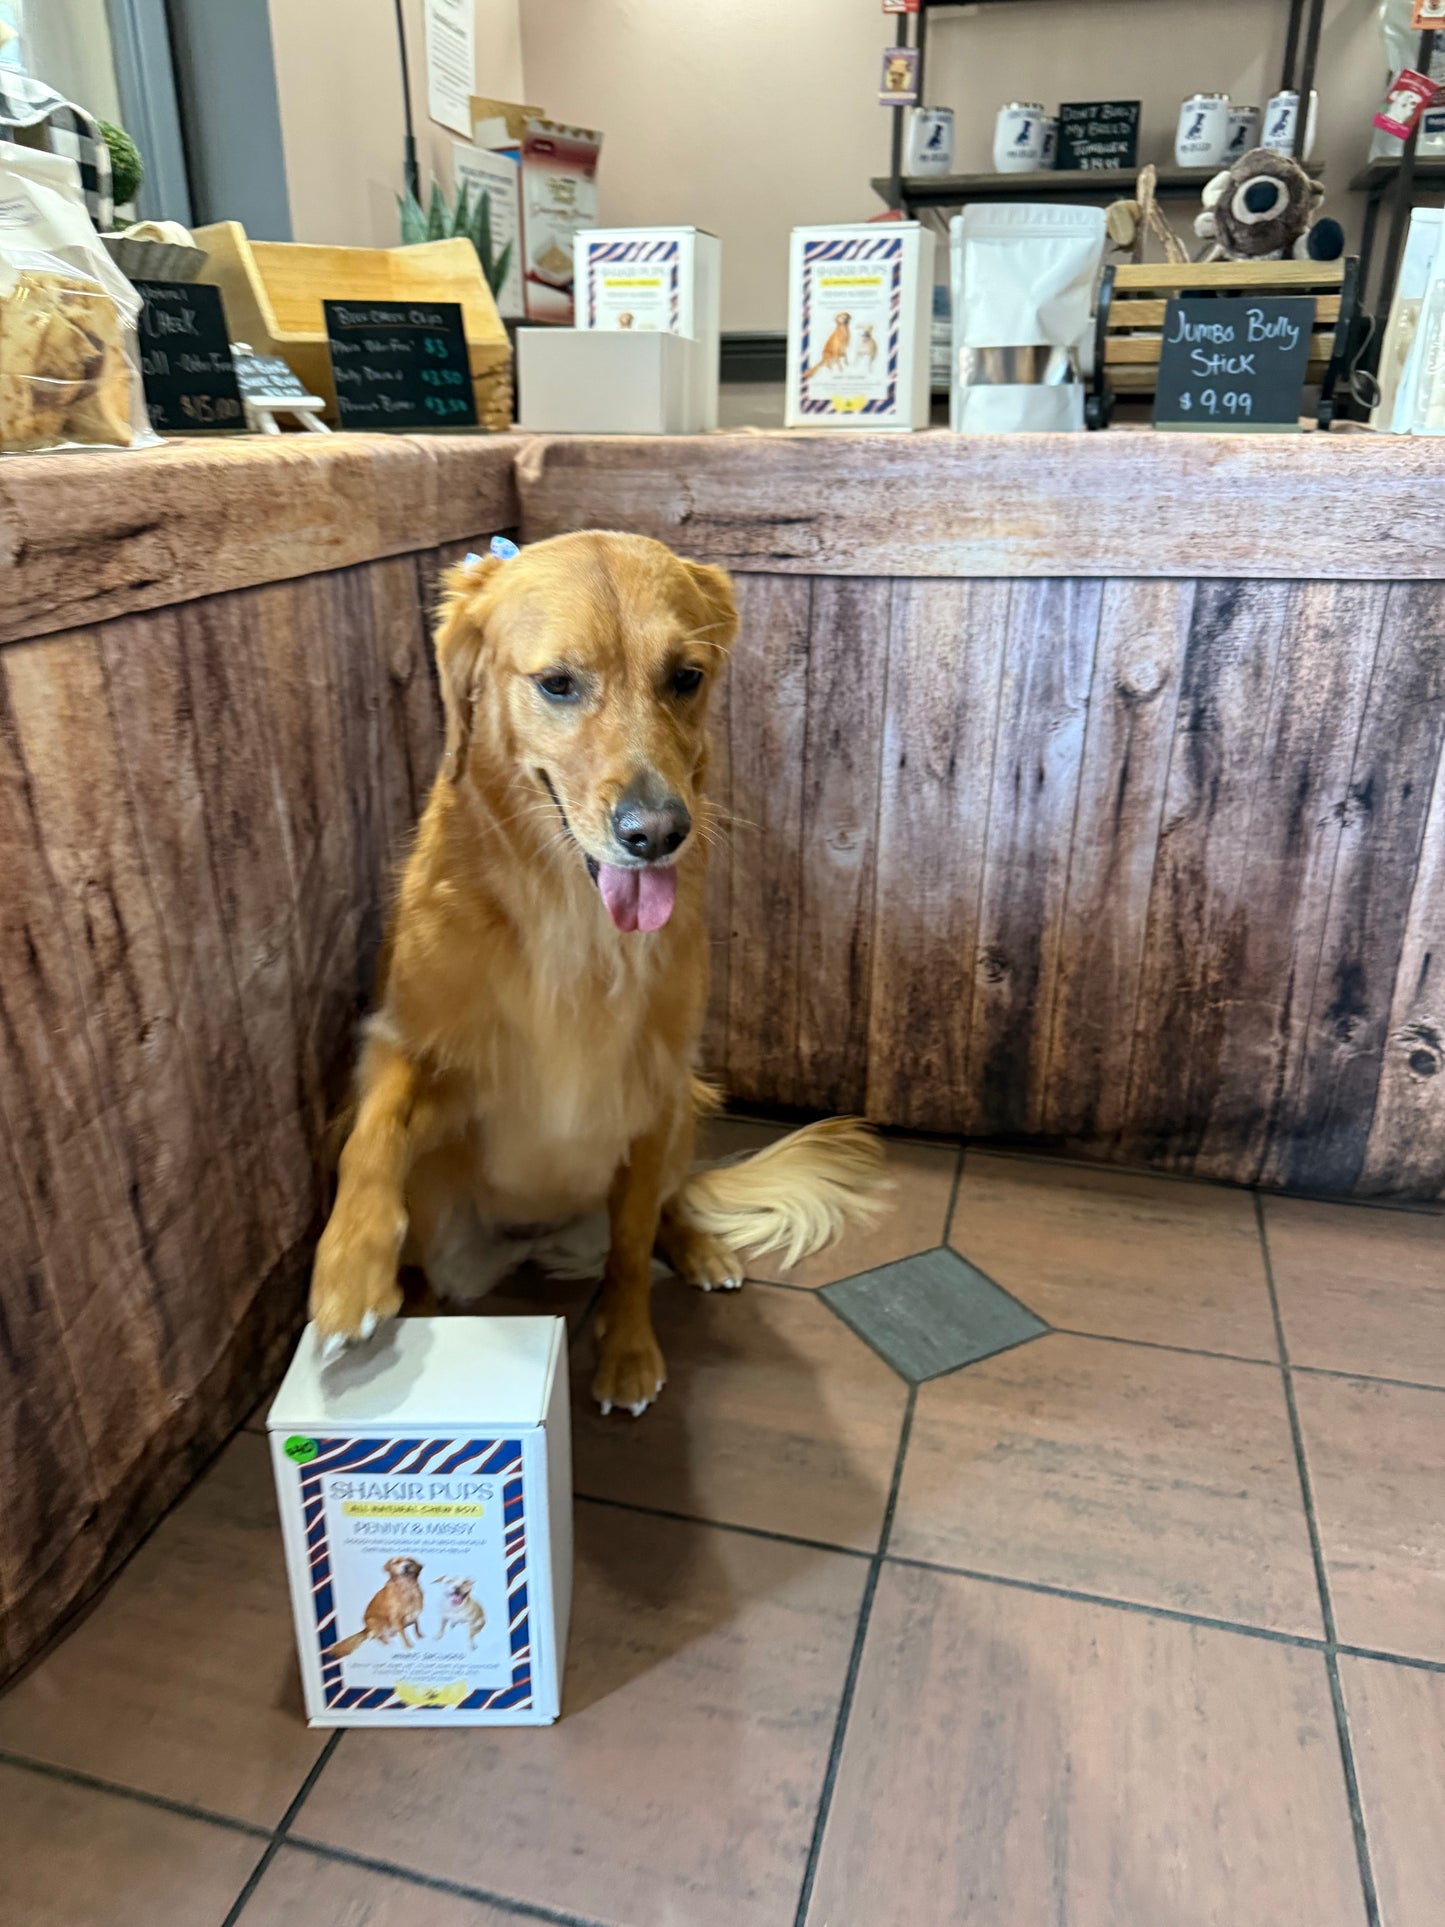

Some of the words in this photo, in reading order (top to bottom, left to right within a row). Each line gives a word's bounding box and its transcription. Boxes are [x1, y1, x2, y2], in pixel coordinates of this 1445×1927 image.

[1246, 308, 1300, 351] Bully
[329, 1480, 425, 1501] SHAKIR
[429, 1481, 495, 1501] PUPS
